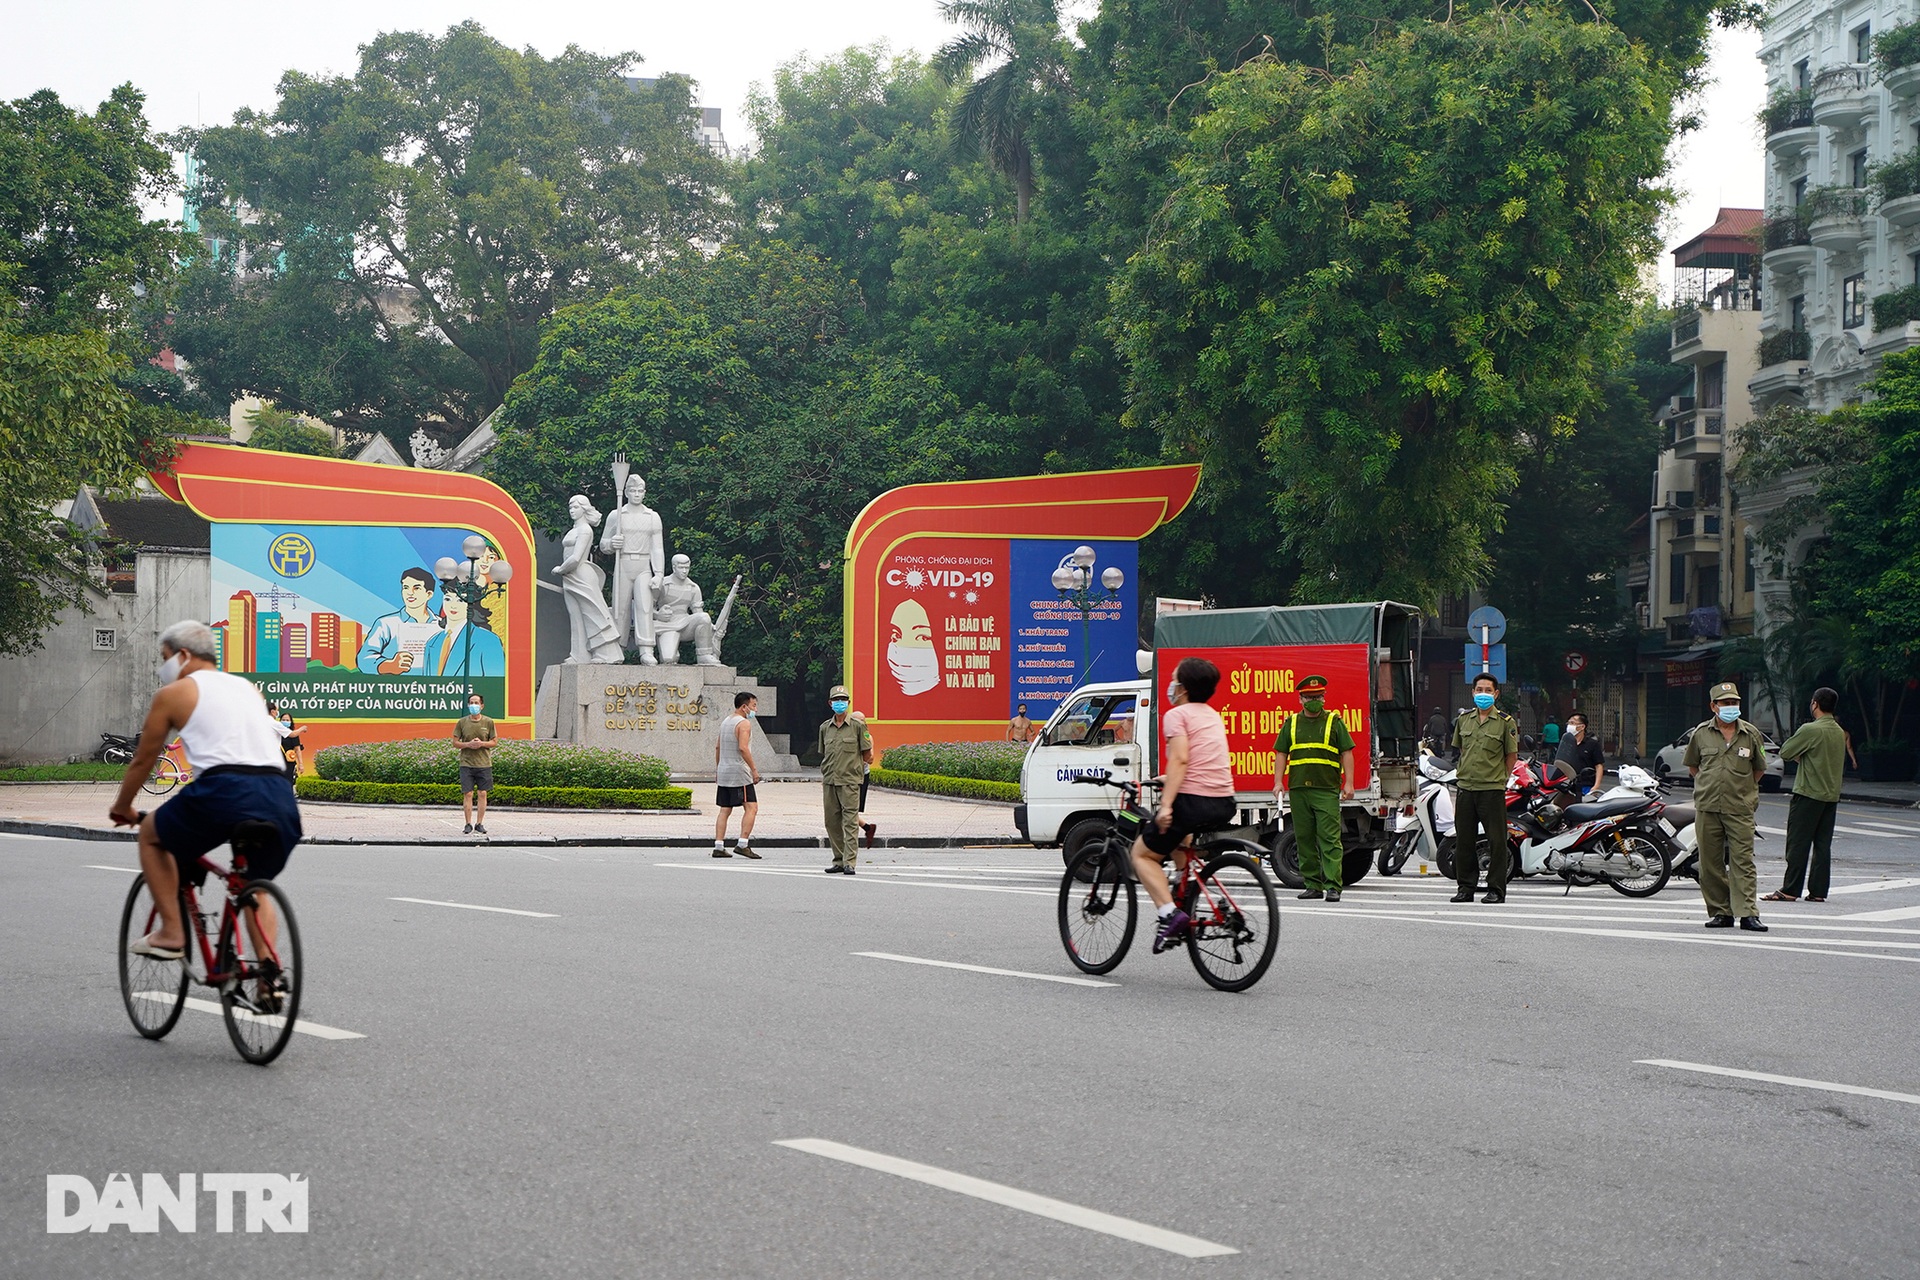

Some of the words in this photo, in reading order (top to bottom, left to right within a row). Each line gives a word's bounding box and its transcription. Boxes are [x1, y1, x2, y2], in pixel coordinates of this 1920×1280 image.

[895, 555, 926, 564] PHÒNG,
[928, 555, 957, 565] CHỐNG
[959, 557, 972, 566] ĐẠI
[974, 557, 993, 566] DỊCH
[1030, 601, 1058, 609] CHUNG
[1033, 610, 1062, 620] CHỐNG
[1087, 612, 1120, 620] OVID-19
[945, 615, 957, 632] LÀ
[960, 614, 979, 632] BẢO
[982, 616, 994, 635] VỆ
[1046, 628, 1069, 636] TRANG
[945, 634, 977, 651] CHÍNH
[979, 637, 1000, 654] BẠN
[945, 655, 962, 669] GIA
[965, 653, 990, 669] ĐÌNH
[1055, 659, 1075, 668] CÁCH
[267, 680, 290, 693] GÌN
[293, 680, 310, 693] VÀ
[313, 680, 345, 693] PHÁT
[348, 683, 374, 694] HUY
[377, 680, 428, 694] TRUYỀN
[945, 671, 960, 688] VÀ
[961, 671, 975, 688] XÃ
[977, 671, 995, 692] HỘI
[1230, 662, 1251, 694] SỬ
[1254, 669, 1294, 699] DỤNG
[605, 681, 657, 698] QUYẾT
[1025, 691, 1051, 700] KHÔNG
[301, 696, 326, 709] TỐT
[328, 698, 352, 712] ĐẸP
[356, 696, 382, 710] CỦA
[385, 696, 427, 710] NGƯỜI
[430, 697, 448, 710] HÀ
[666, 699, 708, 715] QUỐC
[605, 715, 657, 731] QUYẾT
[667, 719, 701, 732] SINH
[1241, 711, 1256, 740] BỊ
[1228, 745, 1276, 775] PHÒNG
